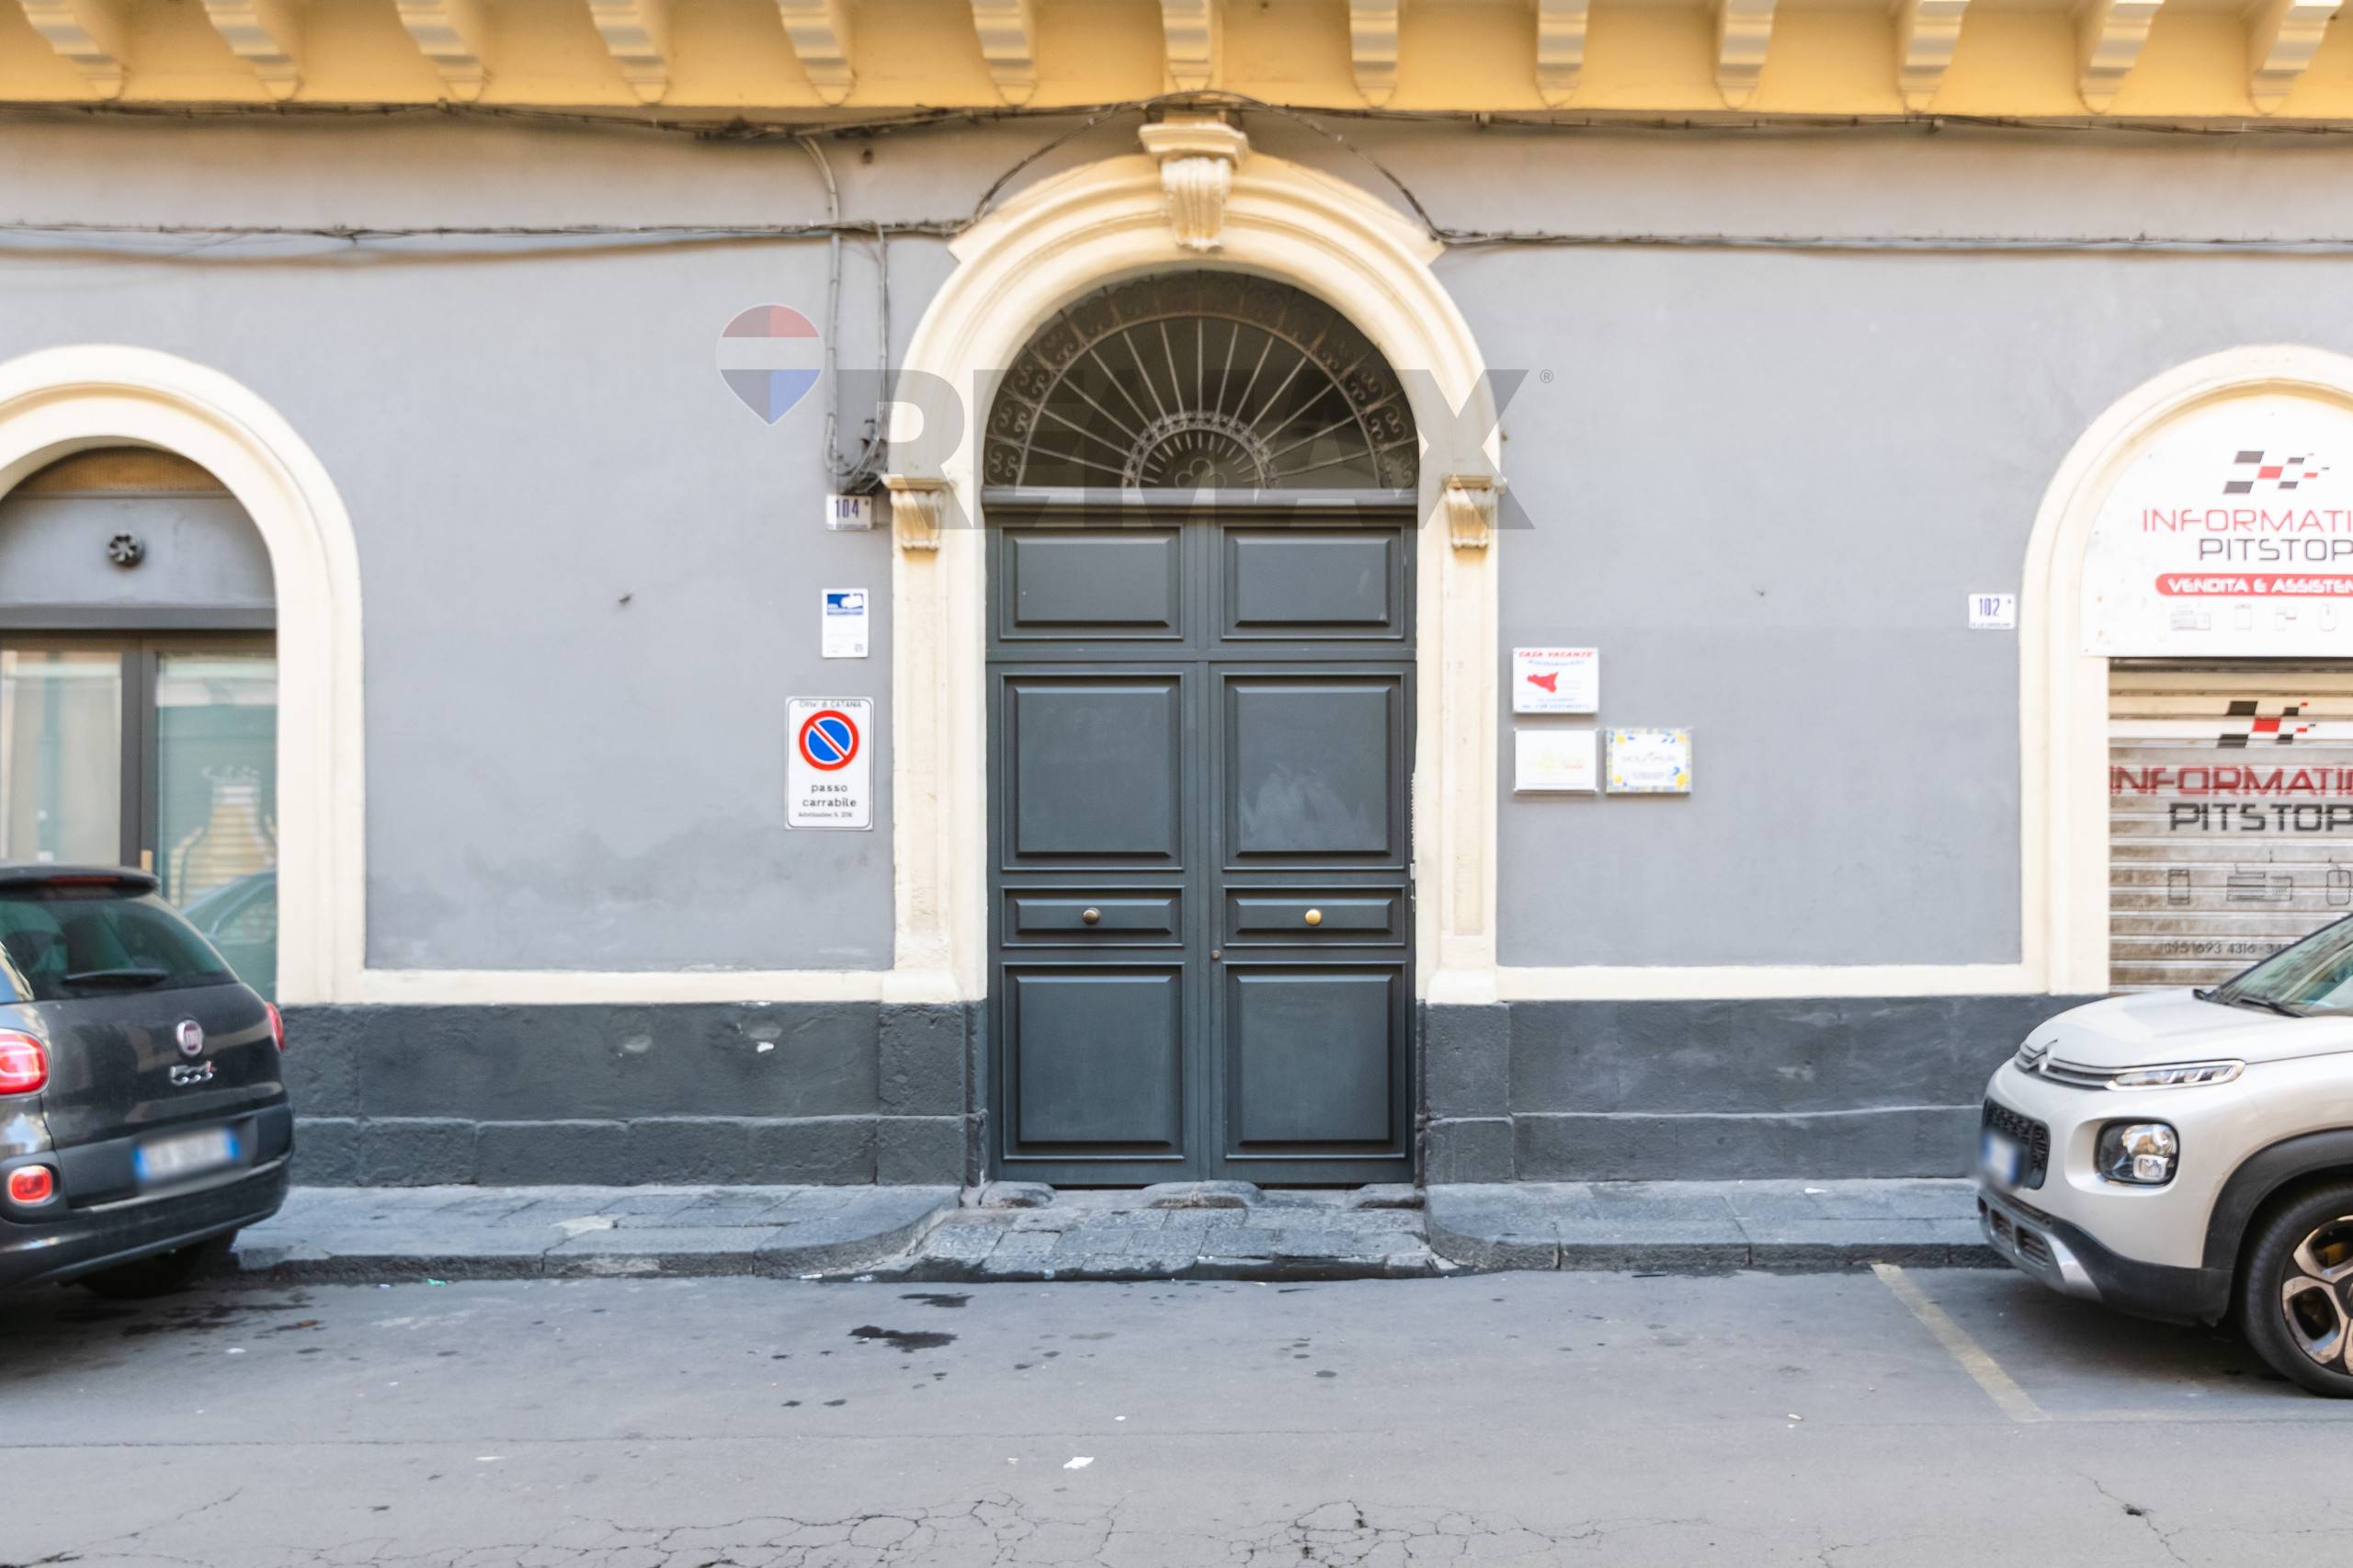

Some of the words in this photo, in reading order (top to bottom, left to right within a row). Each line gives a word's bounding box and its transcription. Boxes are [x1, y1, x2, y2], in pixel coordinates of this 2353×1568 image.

[835, 499, 858, 517] 104
[2199, 539, 2353, 562] PITSTOP
[2167, 578, 2249, 593] VENDITA
[1979, 597, 2001, 617] 102
[811, 784, 848, 793] passo
[2109, 767, 2353, 795] INFORMATI
[802, 798, 858, 807] carrabile
[2169, 803, 2353, 831] PITSTOP
